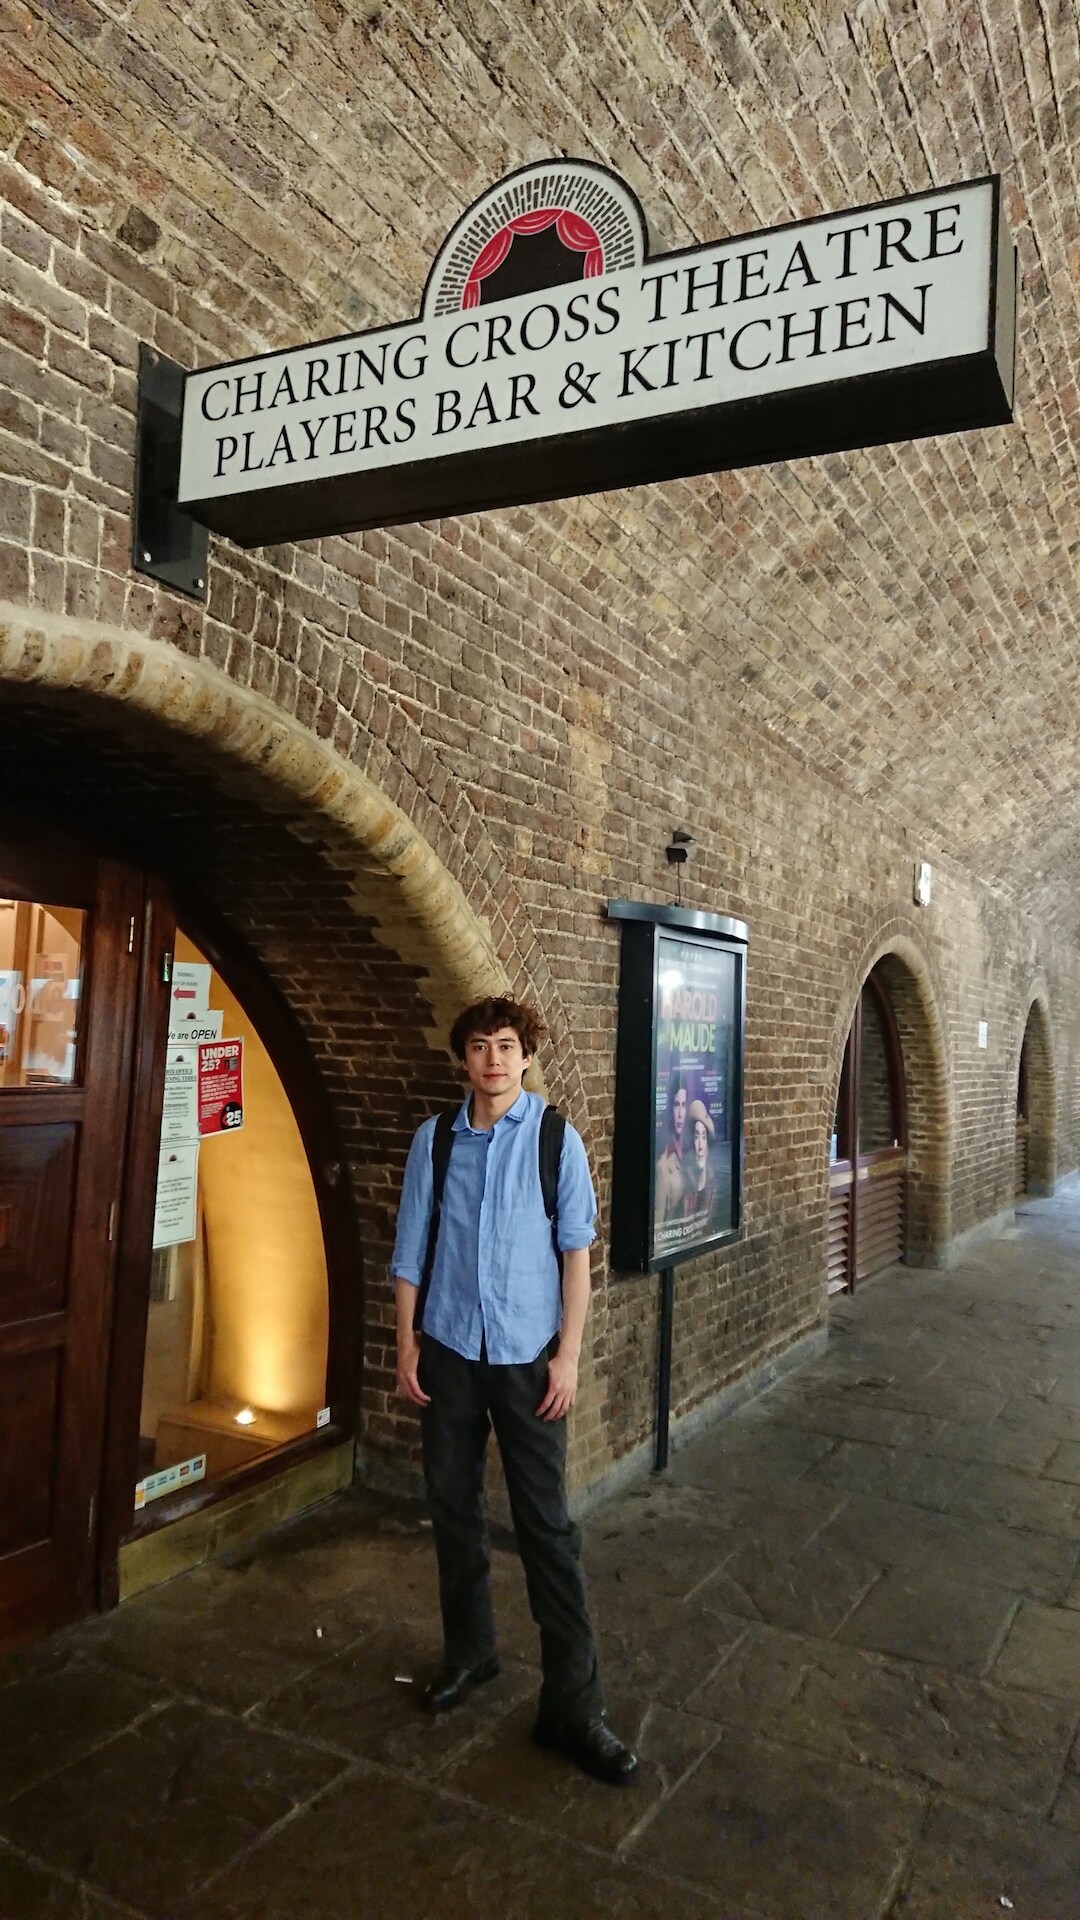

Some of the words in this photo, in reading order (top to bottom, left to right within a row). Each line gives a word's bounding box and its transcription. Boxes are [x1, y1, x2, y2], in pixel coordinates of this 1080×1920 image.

[201, 335, 428, 421] CHARING
[445, 286, 620, 368] CROSS
[641, 203, 964, 323] THEATRE
[213, 398, 416, 477] PLAYERS
[432, 373, 541, 436] BAR
[558, 361, 600, 409] &
[617, 283, 933, 398] KITCHEN
[661, 989, 717, 1022] HAROLD
[191, 1029, 217, 1040] OPEN
[670, 1022, 717, 1053] MAUDE
[201, 1045, 239, 1060] UNDER
[201, 1058, 221, 1072] 25?
[226, 1110, 242, 1127] 25
[657, 1228, 682, 1241] CHARING
